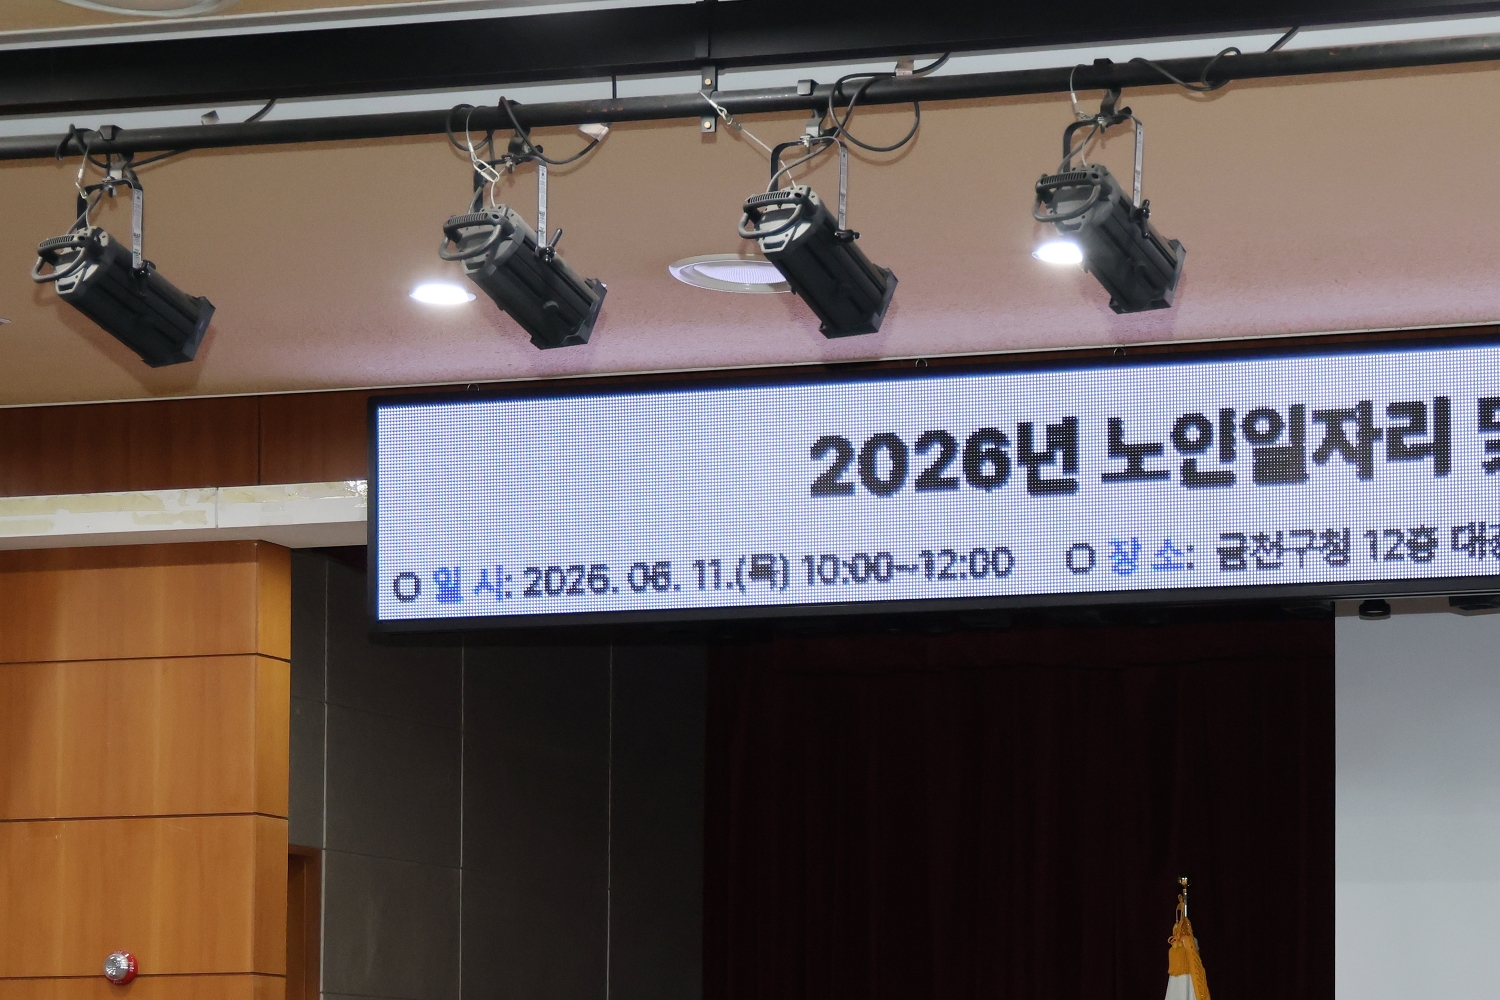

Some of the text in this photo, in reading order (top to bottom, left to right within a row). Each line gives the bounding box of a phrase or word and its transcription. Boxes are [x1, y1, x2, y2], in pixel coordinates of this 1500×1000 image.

[811, 416, 1079, 497] 2026년
[1101, 396, 1451, 489] 노인일자리
[1217, 529, 1350, 571] 금천구청
[1366, 526, 1438, 563] 12층
[524, 564, 618, 597] 2026.
[628, 561, 679, 593] 06.
[695, 554, 789, 592] 11.(목)
